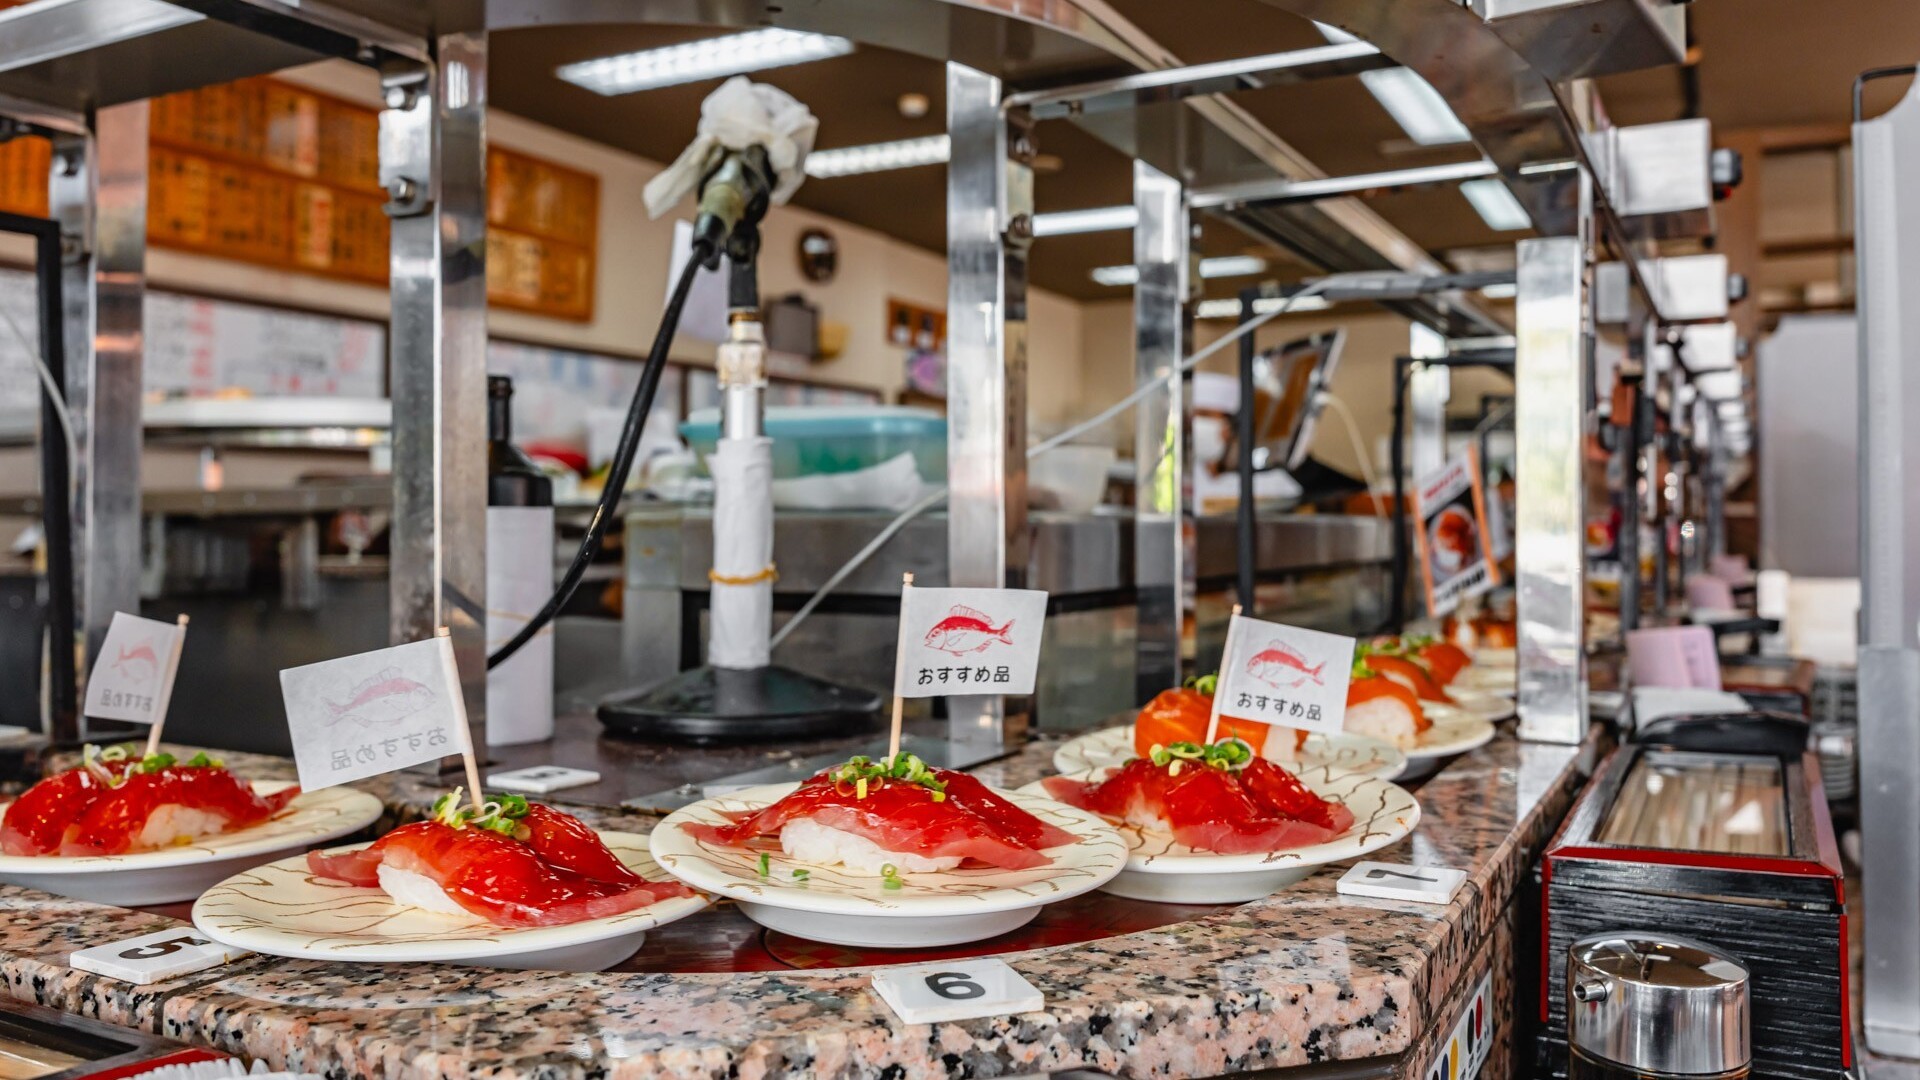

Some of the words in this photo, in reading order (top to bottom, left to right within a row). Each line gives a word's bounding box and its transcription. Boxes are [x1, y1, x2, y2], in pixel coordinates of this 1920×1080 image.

[918, 665, 1011, 686] おすすめ品
[1237, 692, 1322, 722] おすすめ品
[118, 935, 211, 960] 5
[925, 971, 986, 1000] 6
